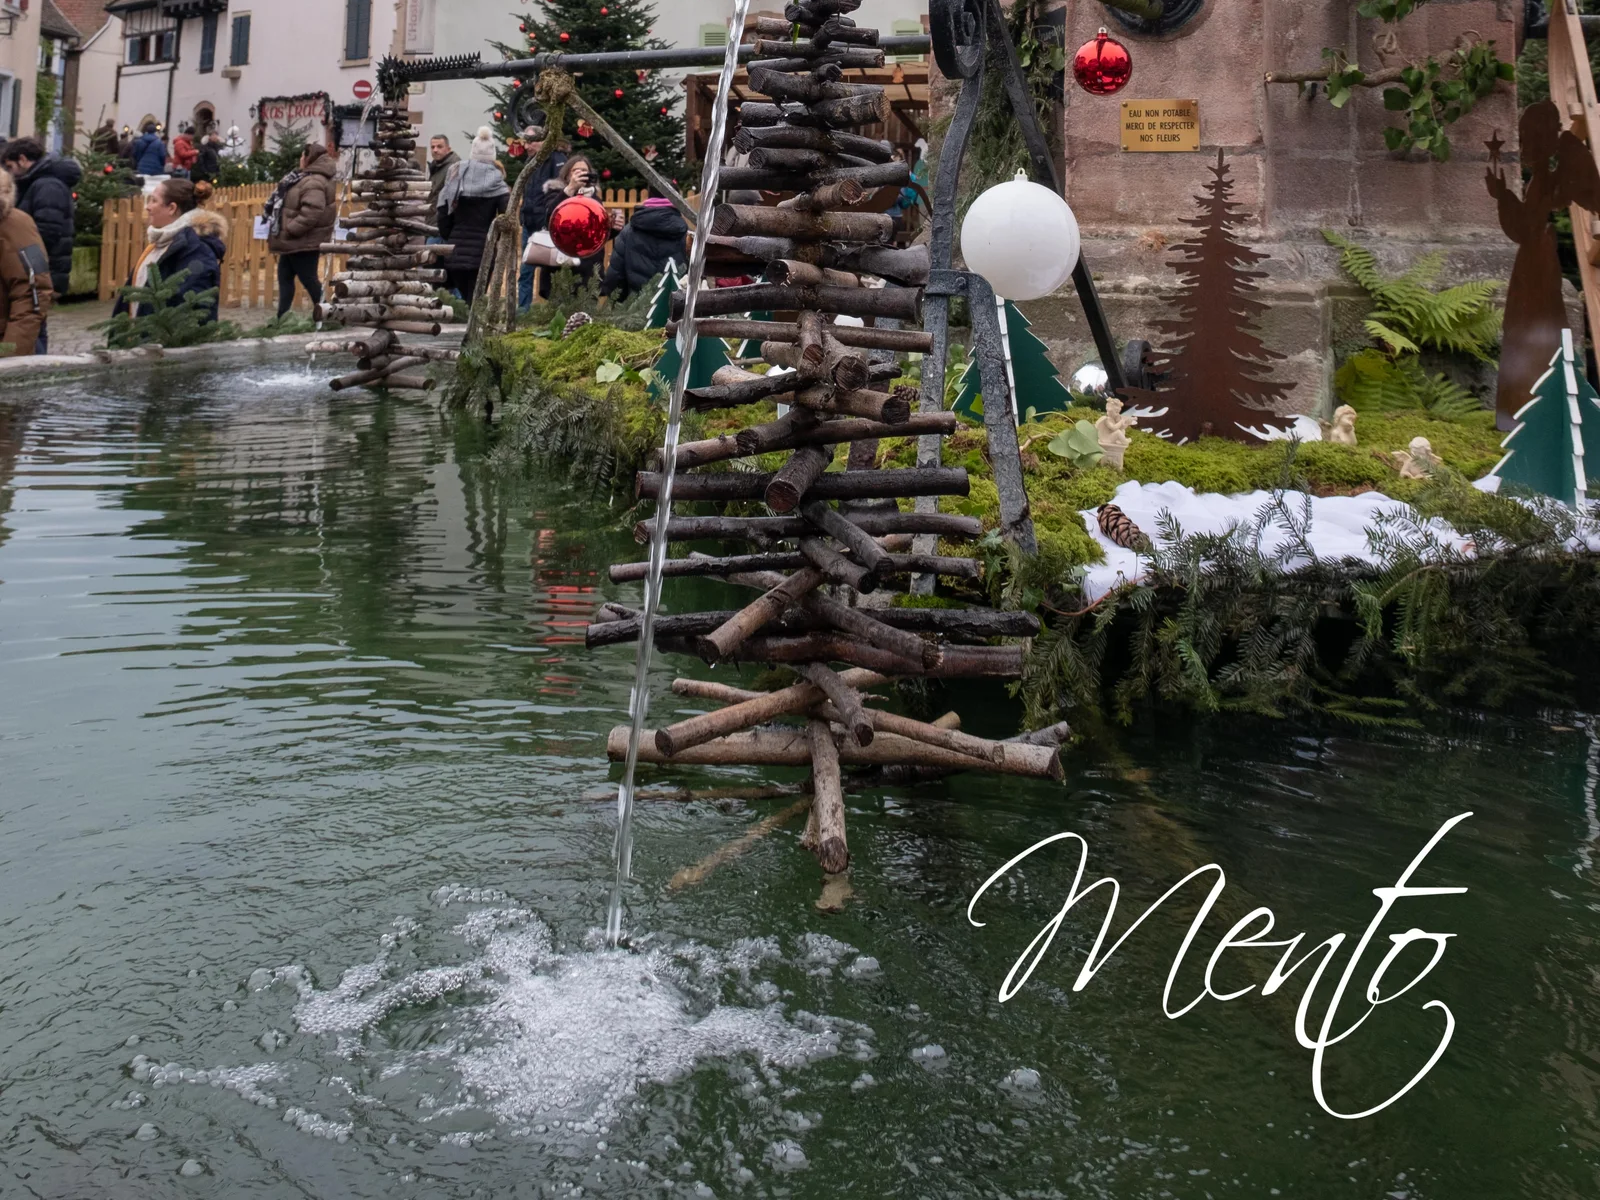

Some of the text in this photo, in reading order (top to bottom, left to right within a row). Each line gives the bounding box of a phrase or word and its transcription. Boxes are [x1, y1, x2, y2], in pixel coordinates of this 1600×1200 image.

[1129, 109, 1191, 118] EAU NON POTABLE
[1125, 121, 1195, 130] MERCI DE RESPECTER
[1140, 134, 1181, 142] NOS FLEURS
